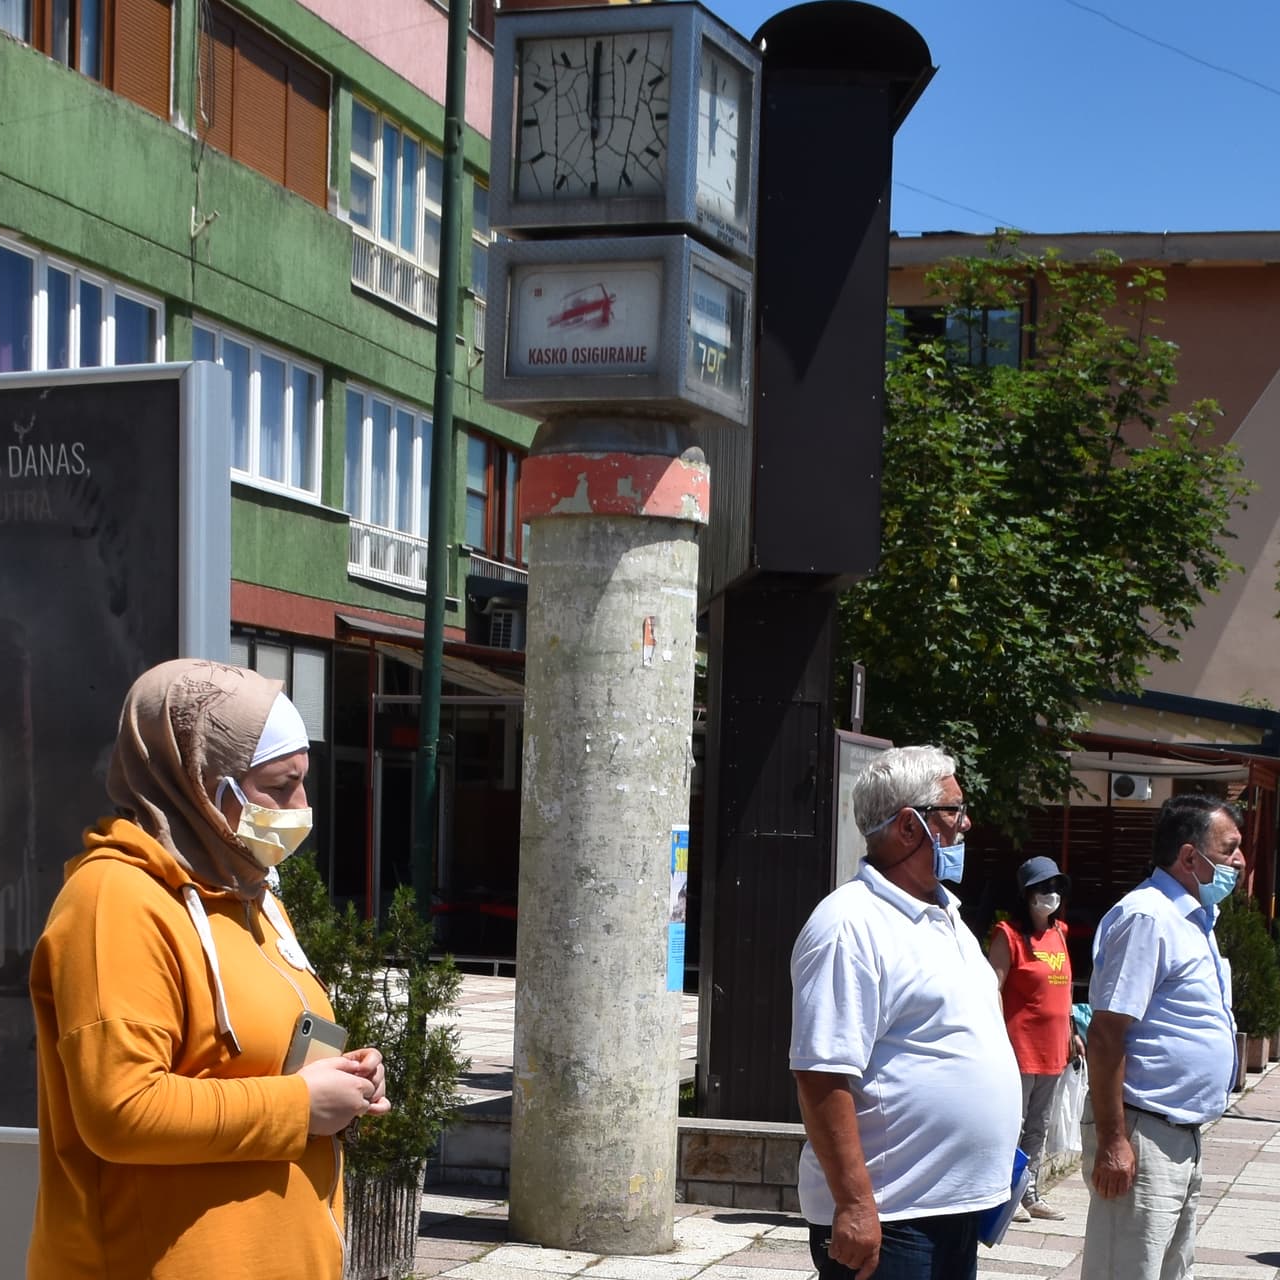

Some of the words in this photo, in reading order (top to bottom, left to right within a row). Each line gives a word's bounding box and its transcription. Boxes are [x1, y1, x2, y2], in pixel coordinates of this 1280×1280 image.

[528, 347, 568, 366] KASKO
[571, 345, 647, 365] OSIGURANJE
[7, 441, 91, 478] DANAS,
